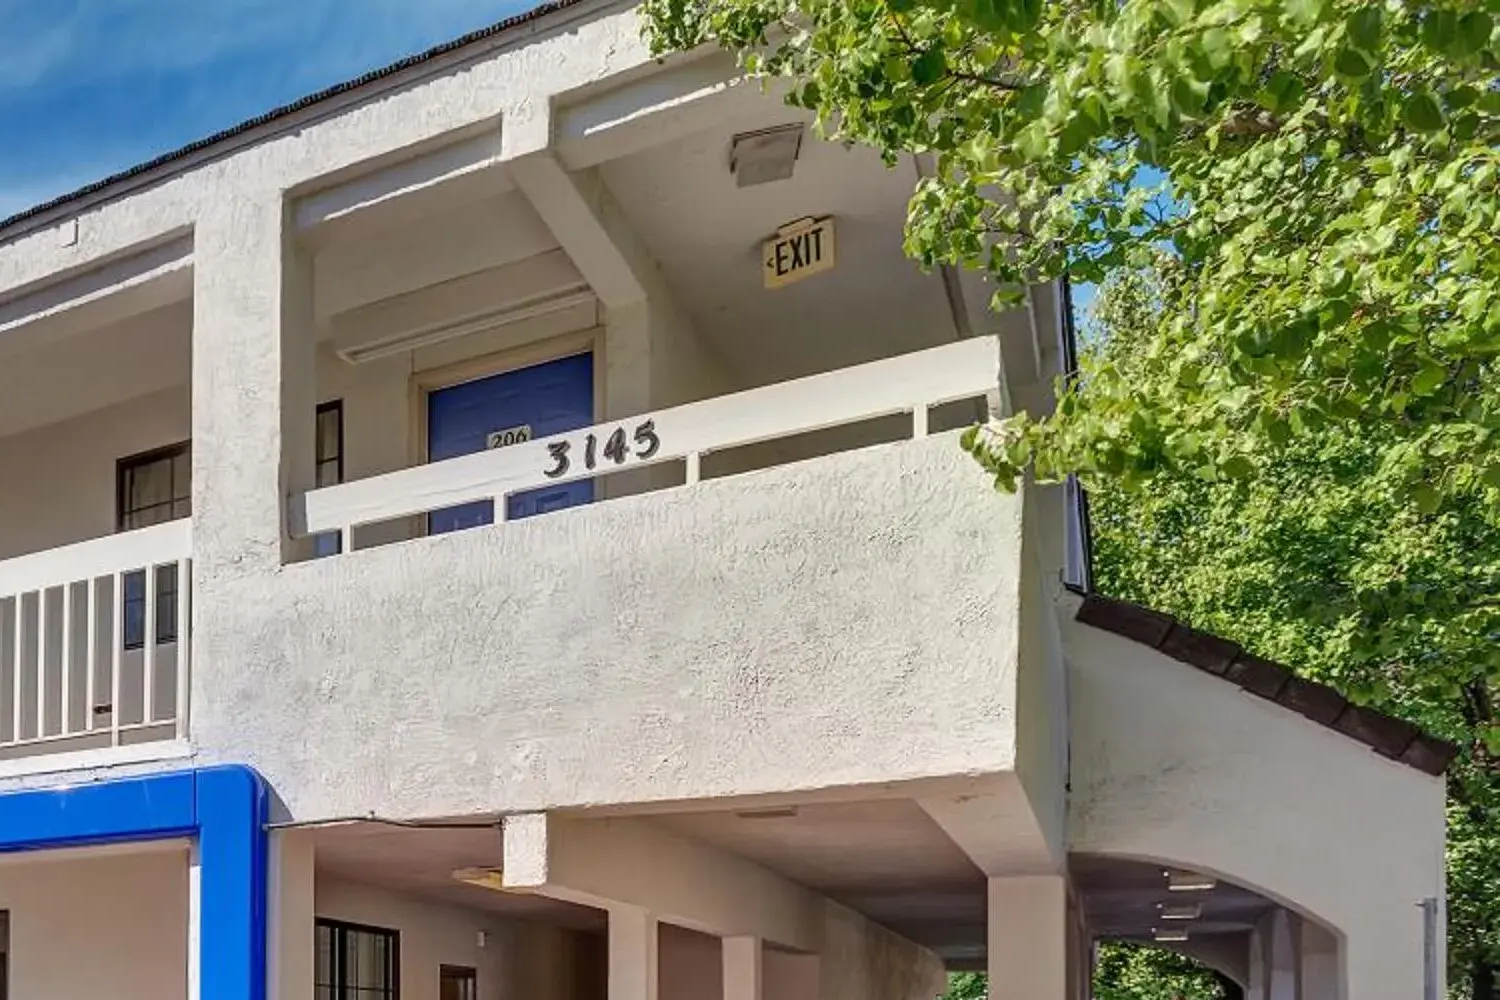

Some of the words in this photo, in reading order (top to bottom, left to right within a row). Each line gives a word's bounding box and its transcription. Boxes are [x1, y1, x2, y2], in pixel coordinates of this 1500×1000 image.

[775, 227, 823, 277] EXIT
[491, 429, 527, 448] 206
[543, 418, 660, 478] 3145
